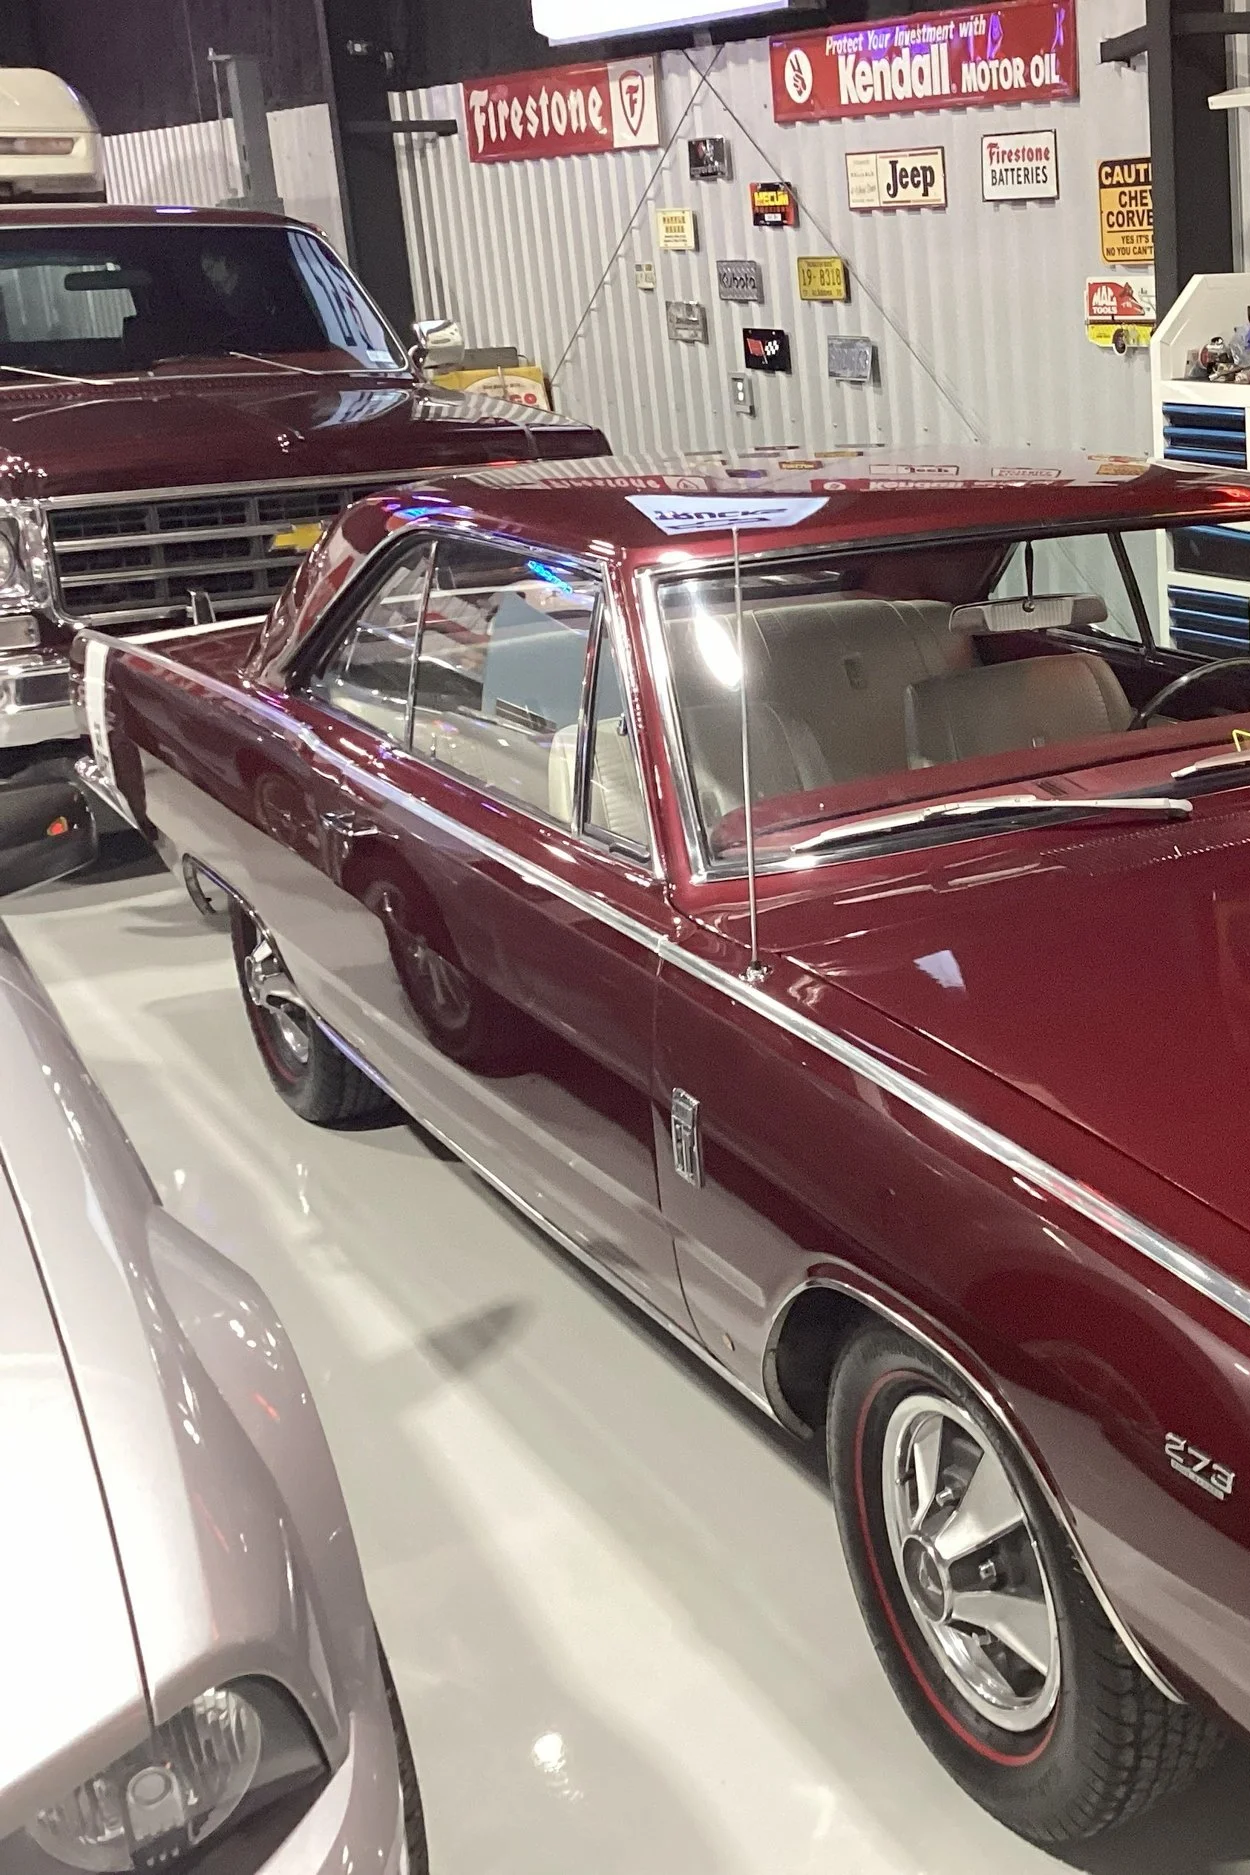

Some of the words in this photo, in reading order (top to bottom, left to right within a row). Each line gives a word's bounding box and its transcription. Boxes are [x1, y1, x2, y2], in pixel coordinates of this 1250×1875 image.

[825, 34, 863, 56] Protect
[867, 28, 890, 50] Your
[894, 20, 953, 46] Investment
[959, 14, 986, 38] with
[837, 43, 950, 105] Kendall
[961, 55, 1026, 94] MOTOR
[1030, 53, 1060, 88] OIL
[469, 85, 608, 154] Firestone
[986, 142, 1051, 166] Firestone
[886, 159, 935, 198] Jeep
[991, 165, 1048, 187] BATTERIES
[1101, 163, 1153, 186] CAUTI
[1118, 189, 1153, 208] CHE
[1106, 208, 1153, 228] CORVE
[1106, 246, 1116, 256] NO
[1117, 246, 1131, 256] YOU
[1132, 245, 1153, 256] CAN'T
[1121, 235, 1135, 245] YES
[1136, 234, 1150, 244] IT'S
[1092, 285, 1117, 307] MAC
[1092, 306, 1118, 315] TOOLS
[1165, 1431, 1236, 1494] 273
